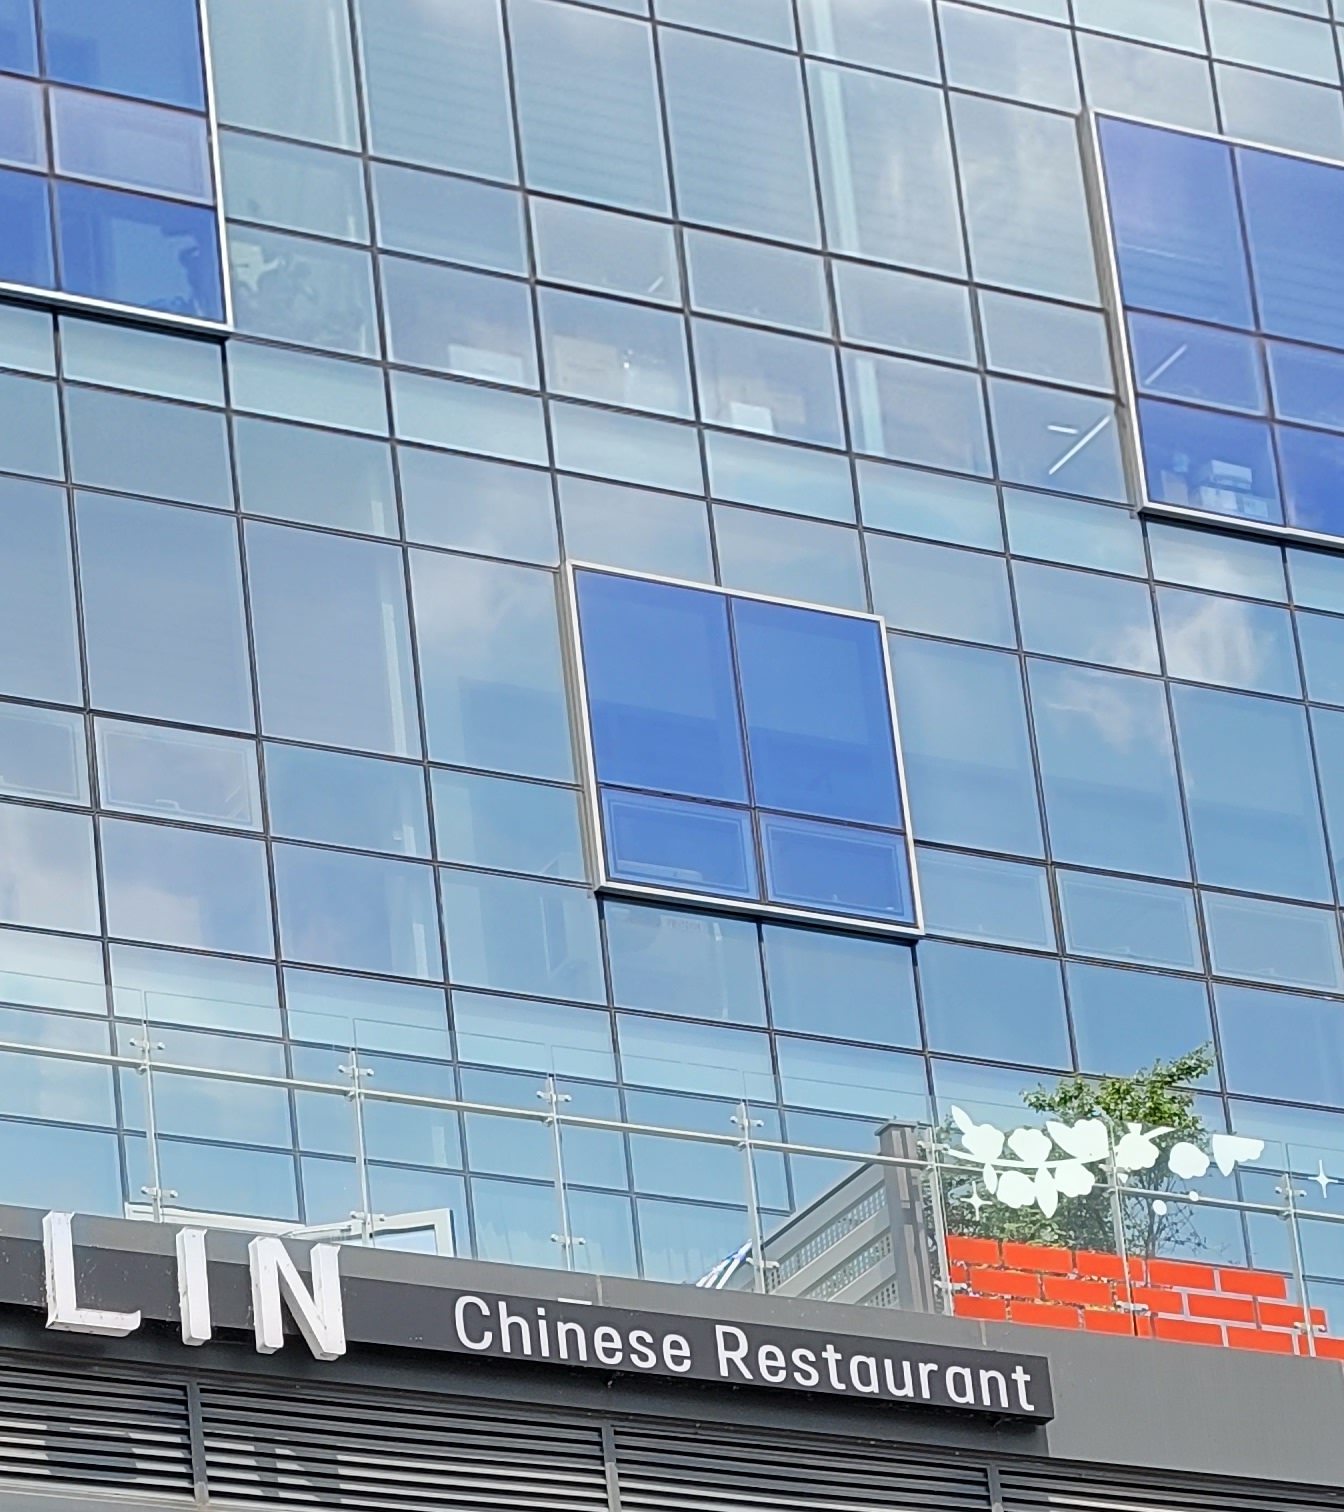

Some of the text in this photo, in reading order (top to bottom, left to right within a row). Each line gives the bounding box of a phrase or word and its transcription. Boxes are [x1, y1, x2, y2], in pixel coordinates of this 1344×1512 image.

[41, 1210, 344, 1361] LIN
[454, 1295, 1036, 1413] Chinese Restaurant
